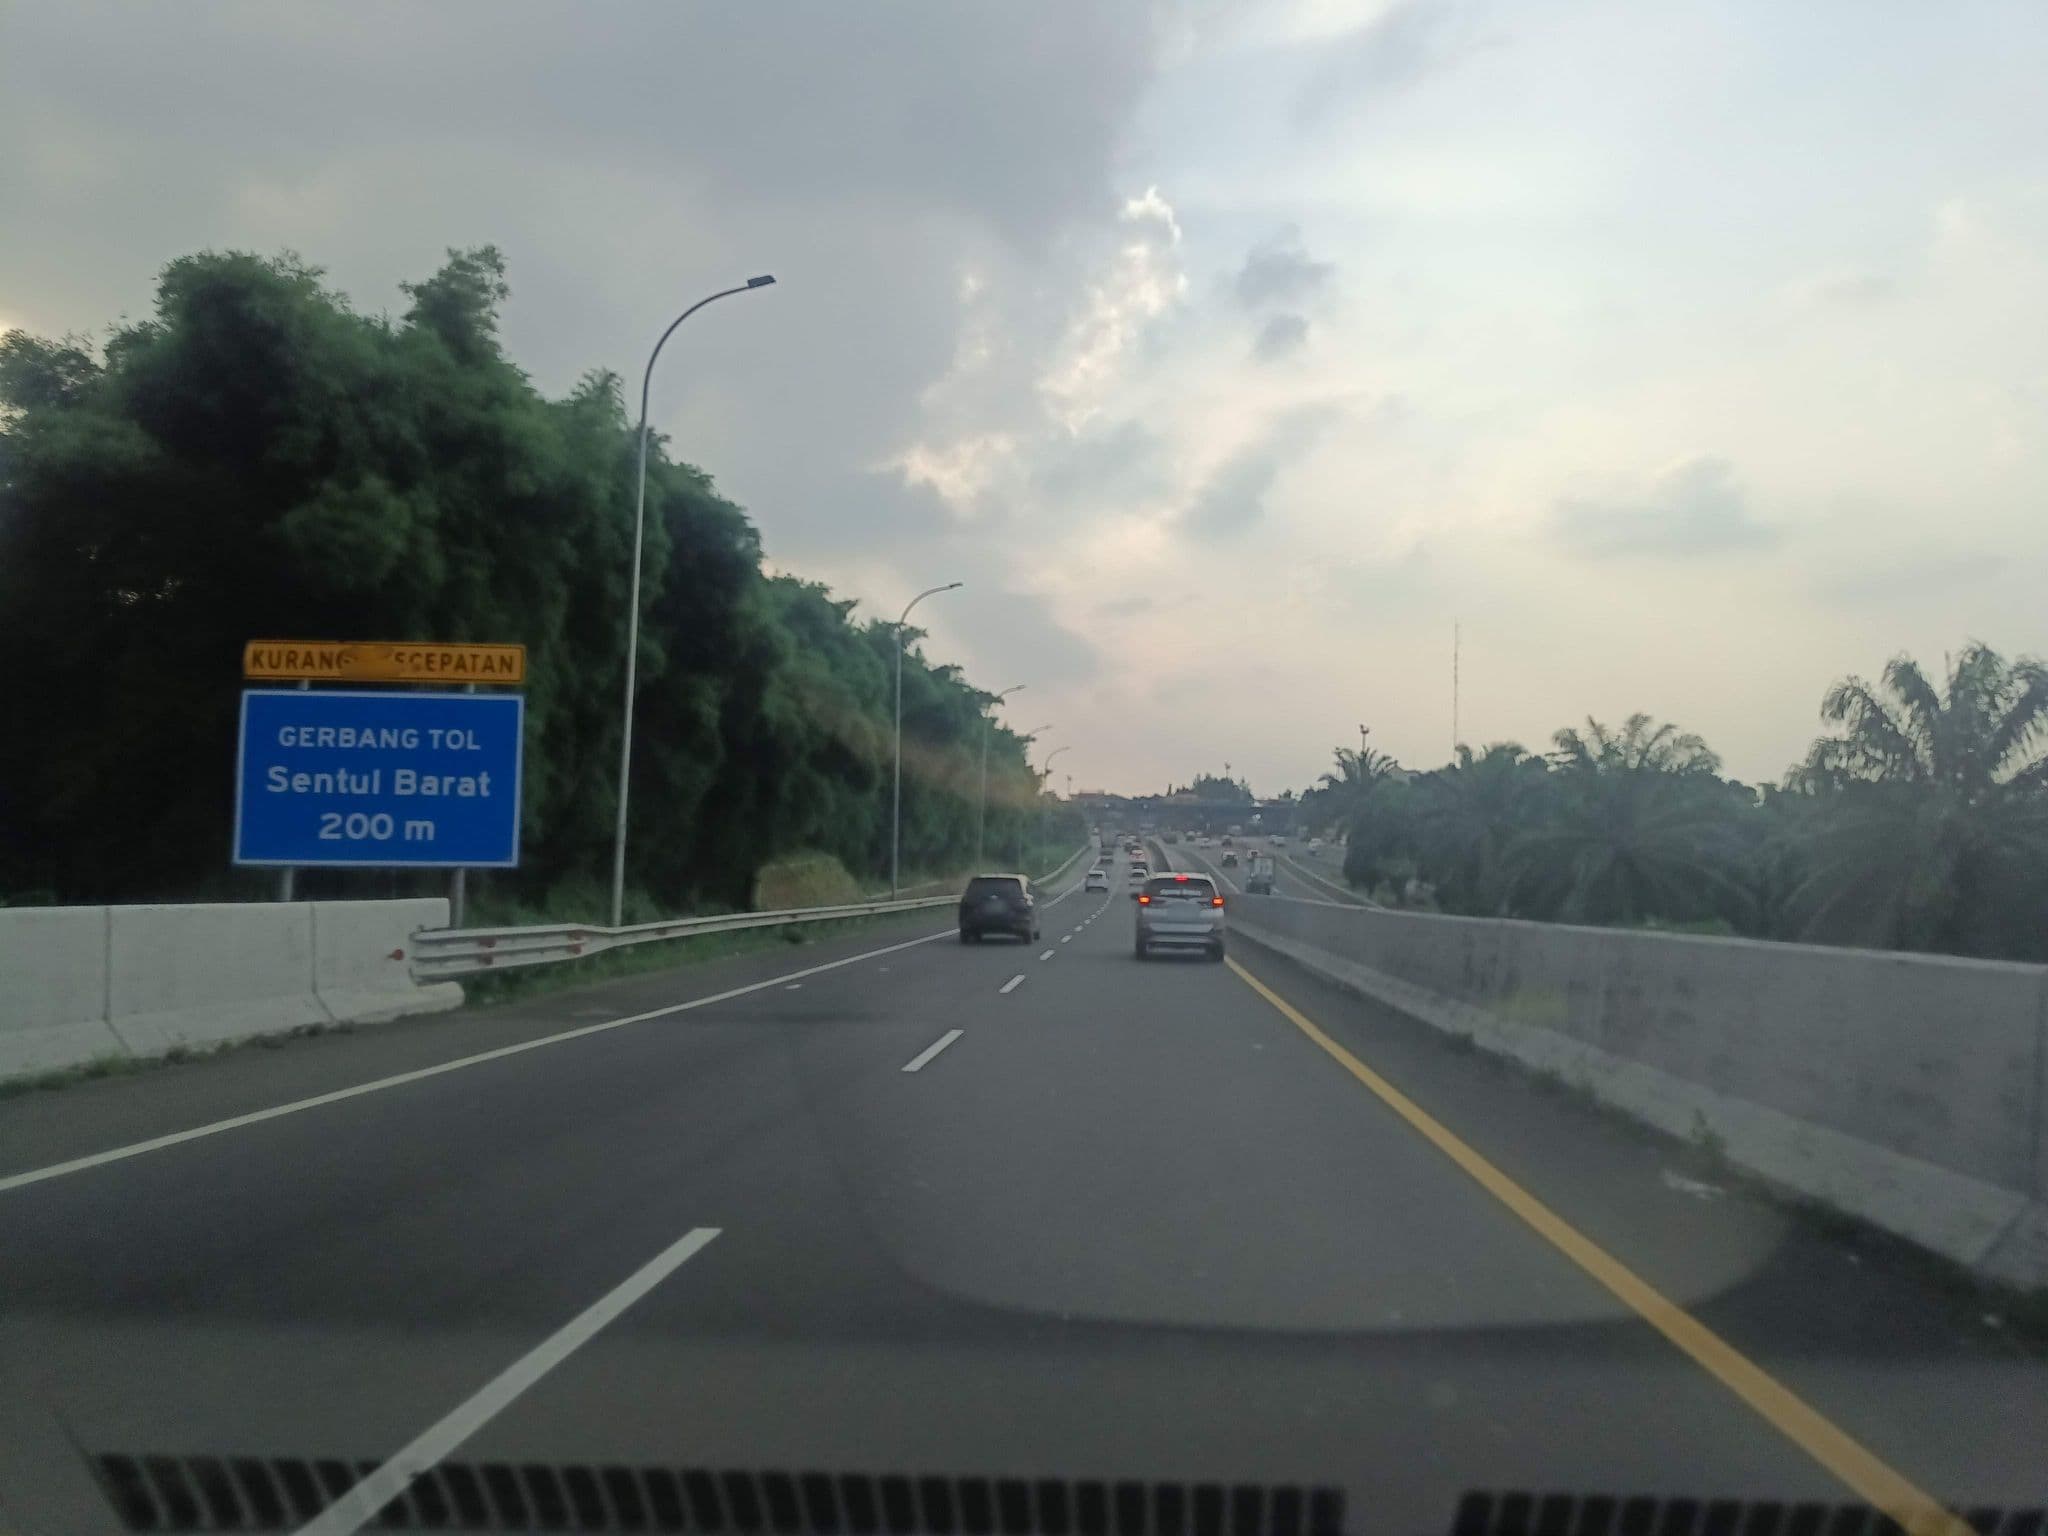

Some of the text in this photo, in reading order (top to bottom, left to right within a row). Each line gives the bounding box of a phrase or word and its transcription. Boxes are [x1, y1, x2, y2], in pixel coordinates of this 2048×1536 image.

[278, 726, 481, 750] GERBANG TOL
[266, 765, 491, 797] Sentul Barat
[319, 812, 435, 840] 200 m
